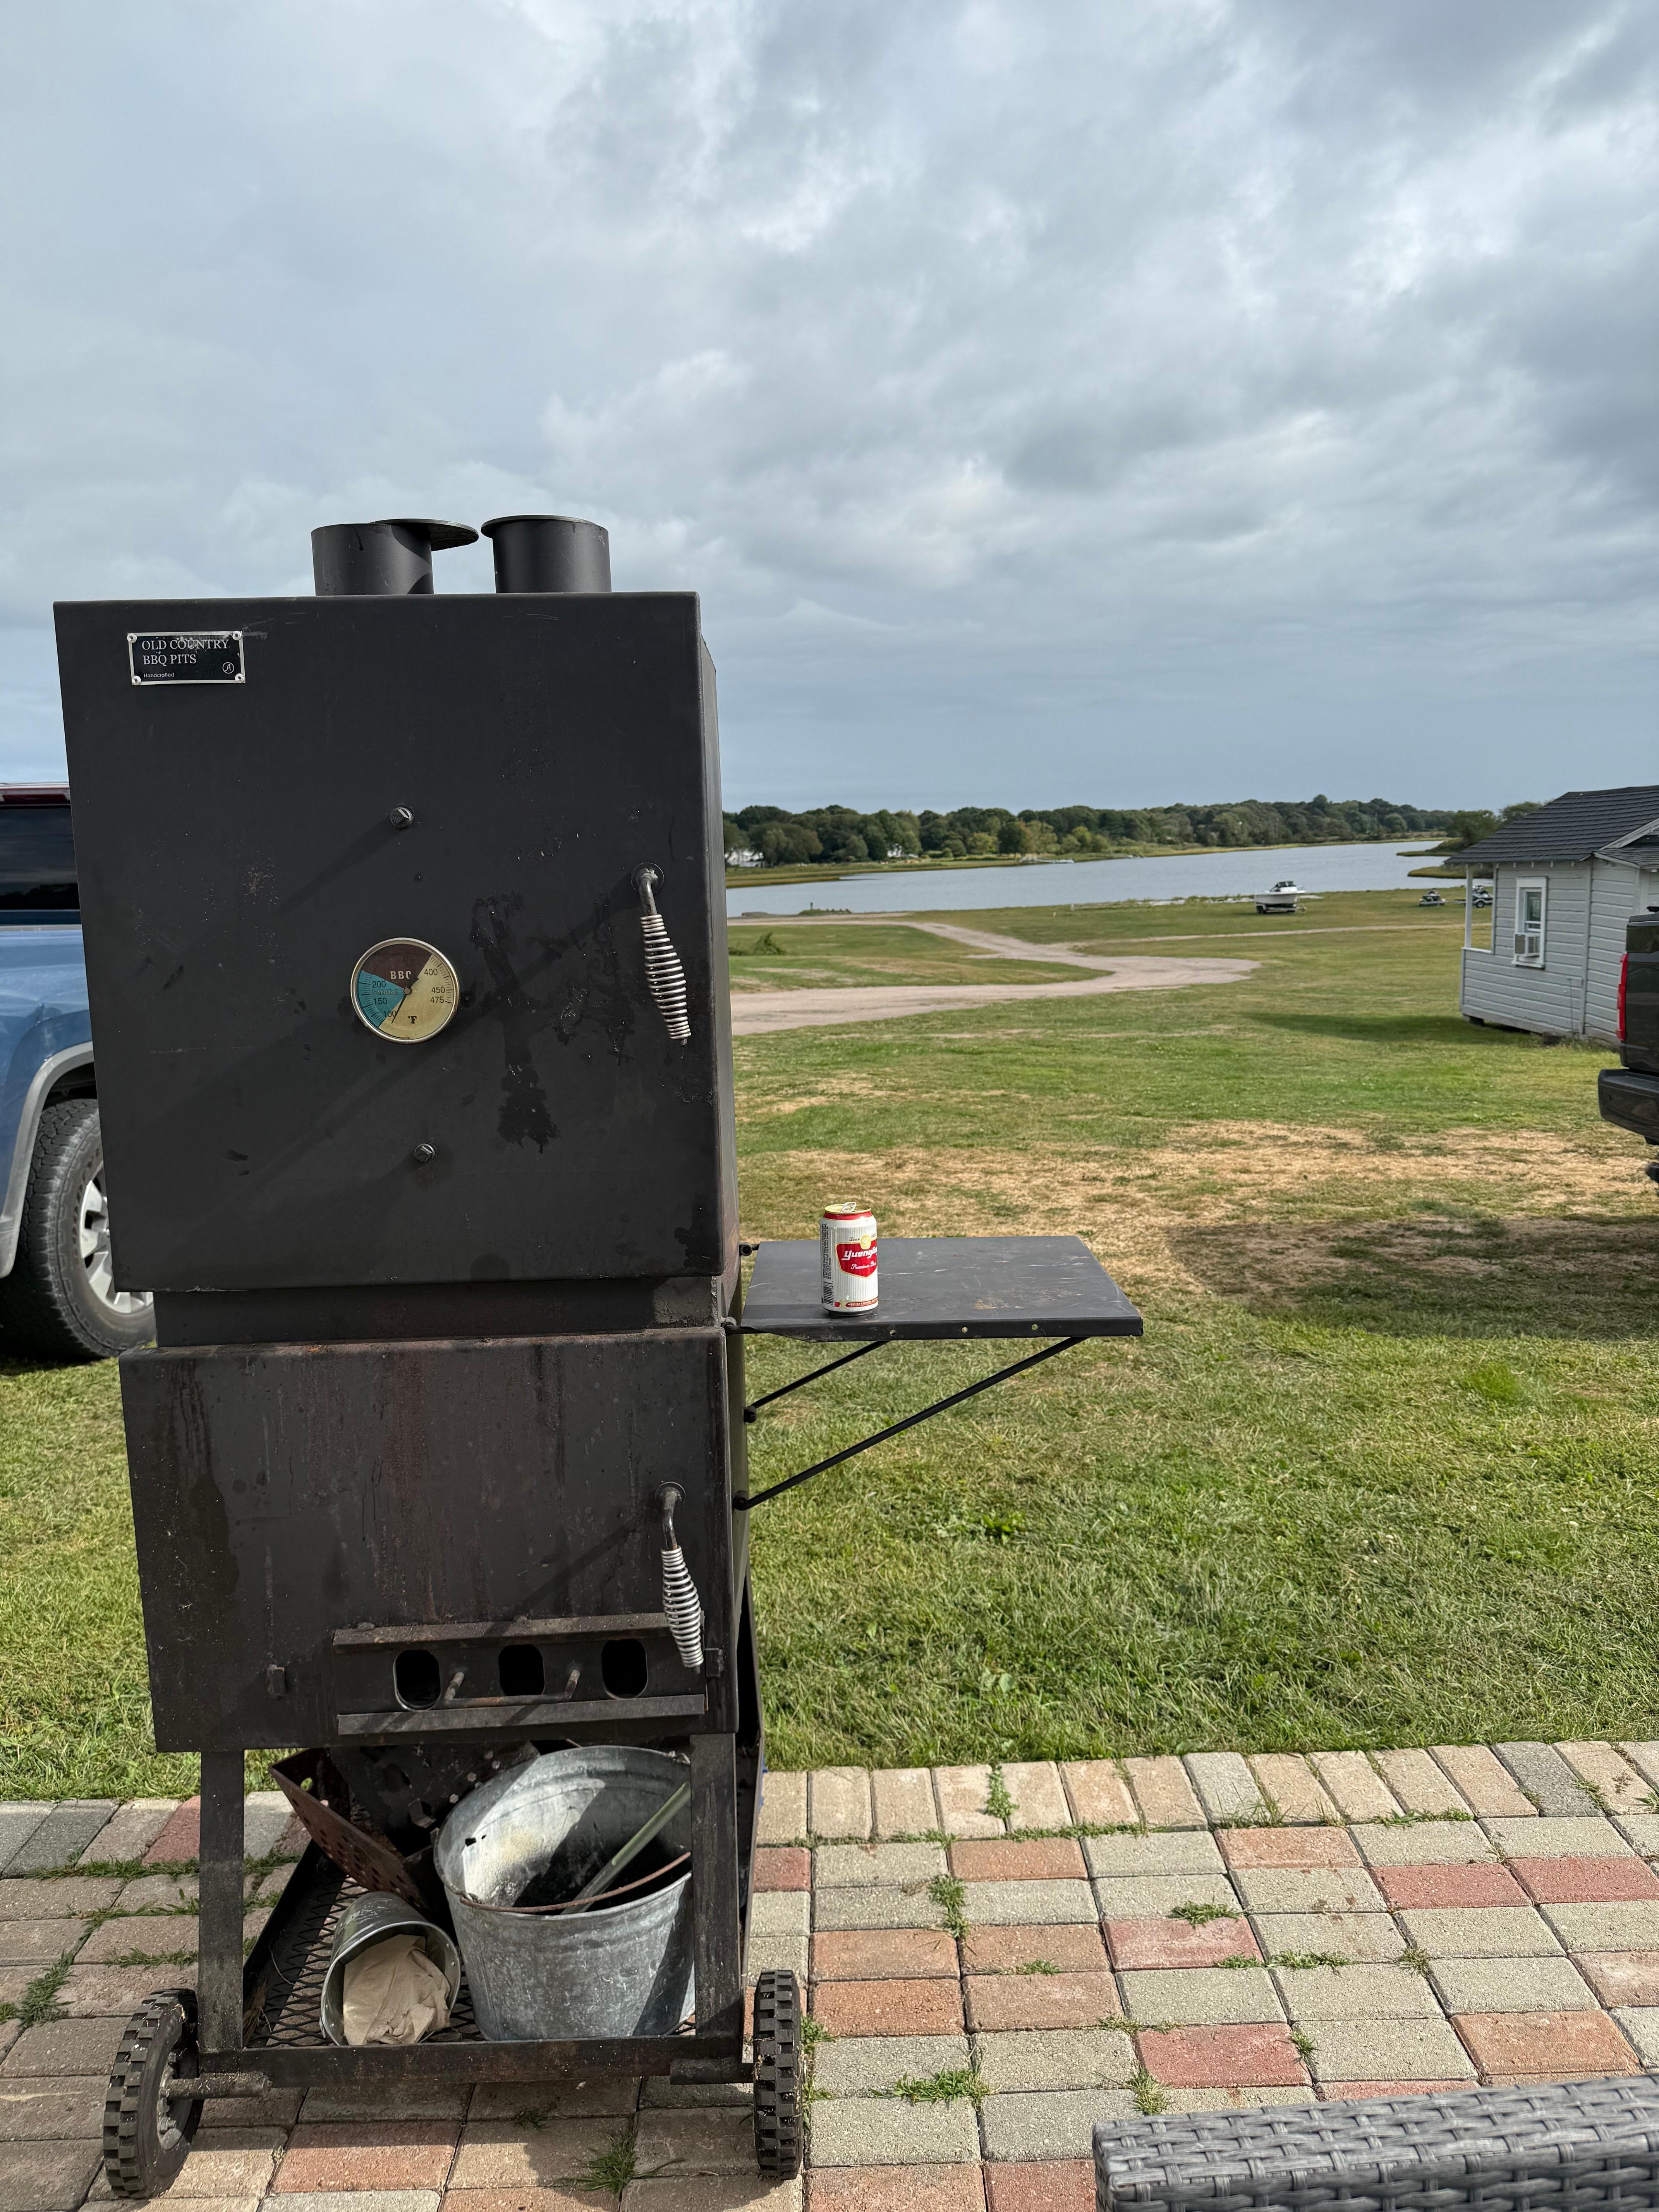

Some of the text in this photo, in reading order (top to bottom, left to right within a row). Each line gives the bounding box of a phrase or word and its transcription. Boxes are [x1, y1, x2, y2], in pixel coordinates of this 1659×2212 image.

[142, 639, 229, 650] OLD COUNTRY
[143, 654, 197, 666] BBQ PITS
